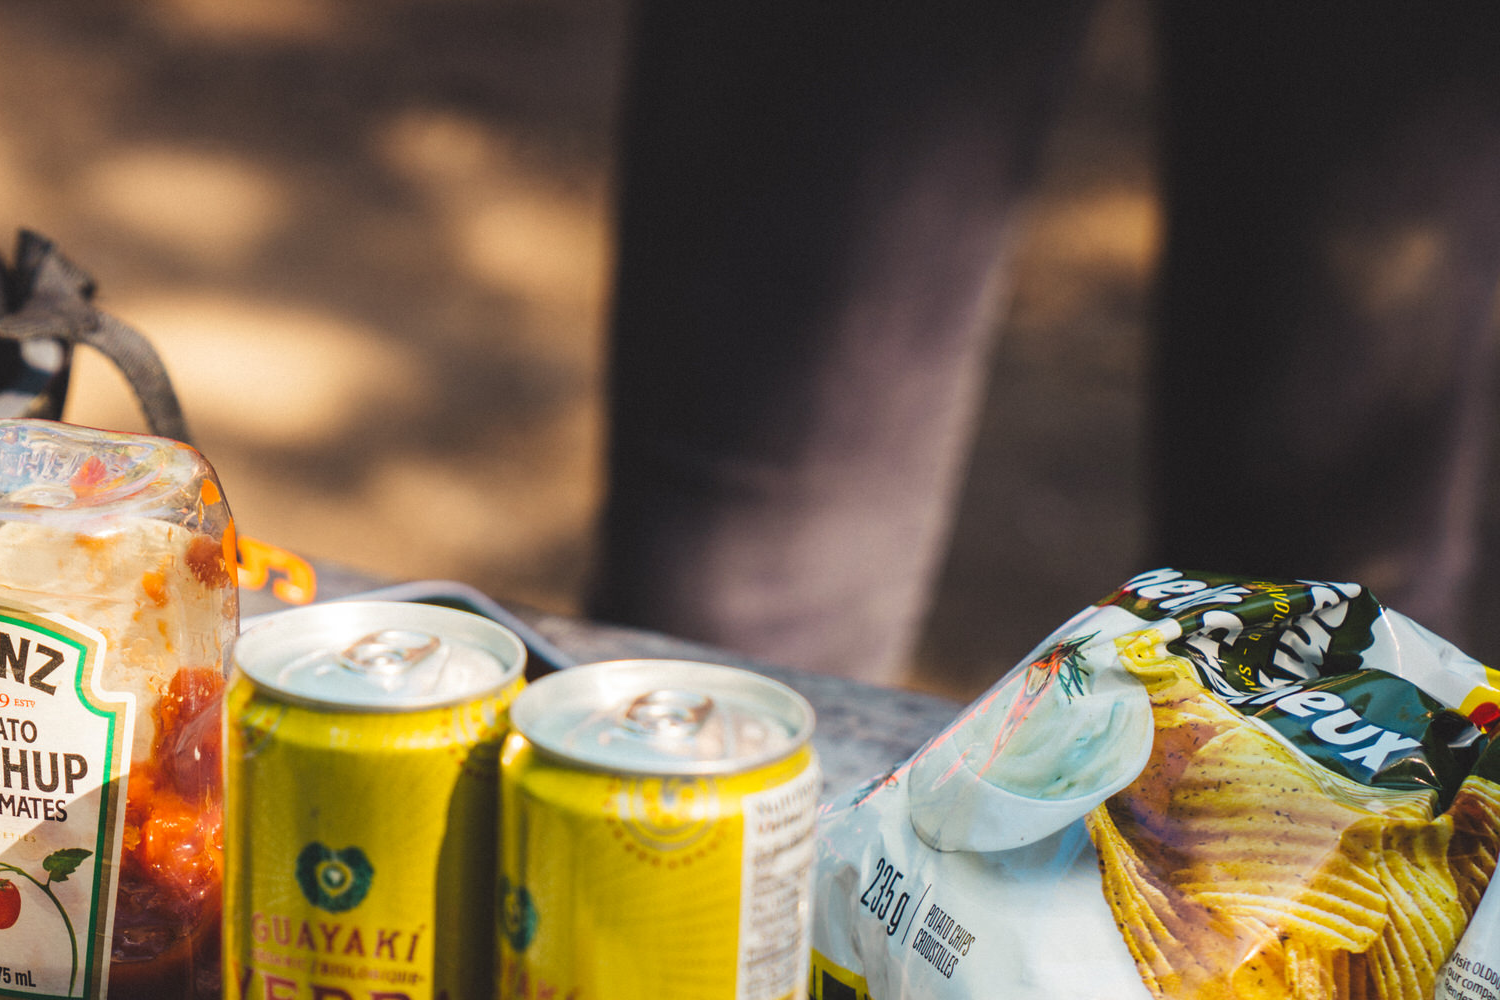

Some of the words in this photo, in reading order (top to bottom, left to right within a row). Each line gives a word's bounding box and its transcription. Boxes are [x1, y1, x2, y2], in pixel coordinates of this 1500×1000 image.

[1121, 566, 1252, 618] neth
[252, 910, 427, 963] GUAYAKÍ
[912, 928, 959, 979] CROUSTILLES
[924, 904, 955, 940] POTATO
[948, 924, 976, 957] CHIPS
[15, 970, 36, 987] mL
[1447, 966, 1462, 983] our
[1452, 952, 1471, 971] Visit
